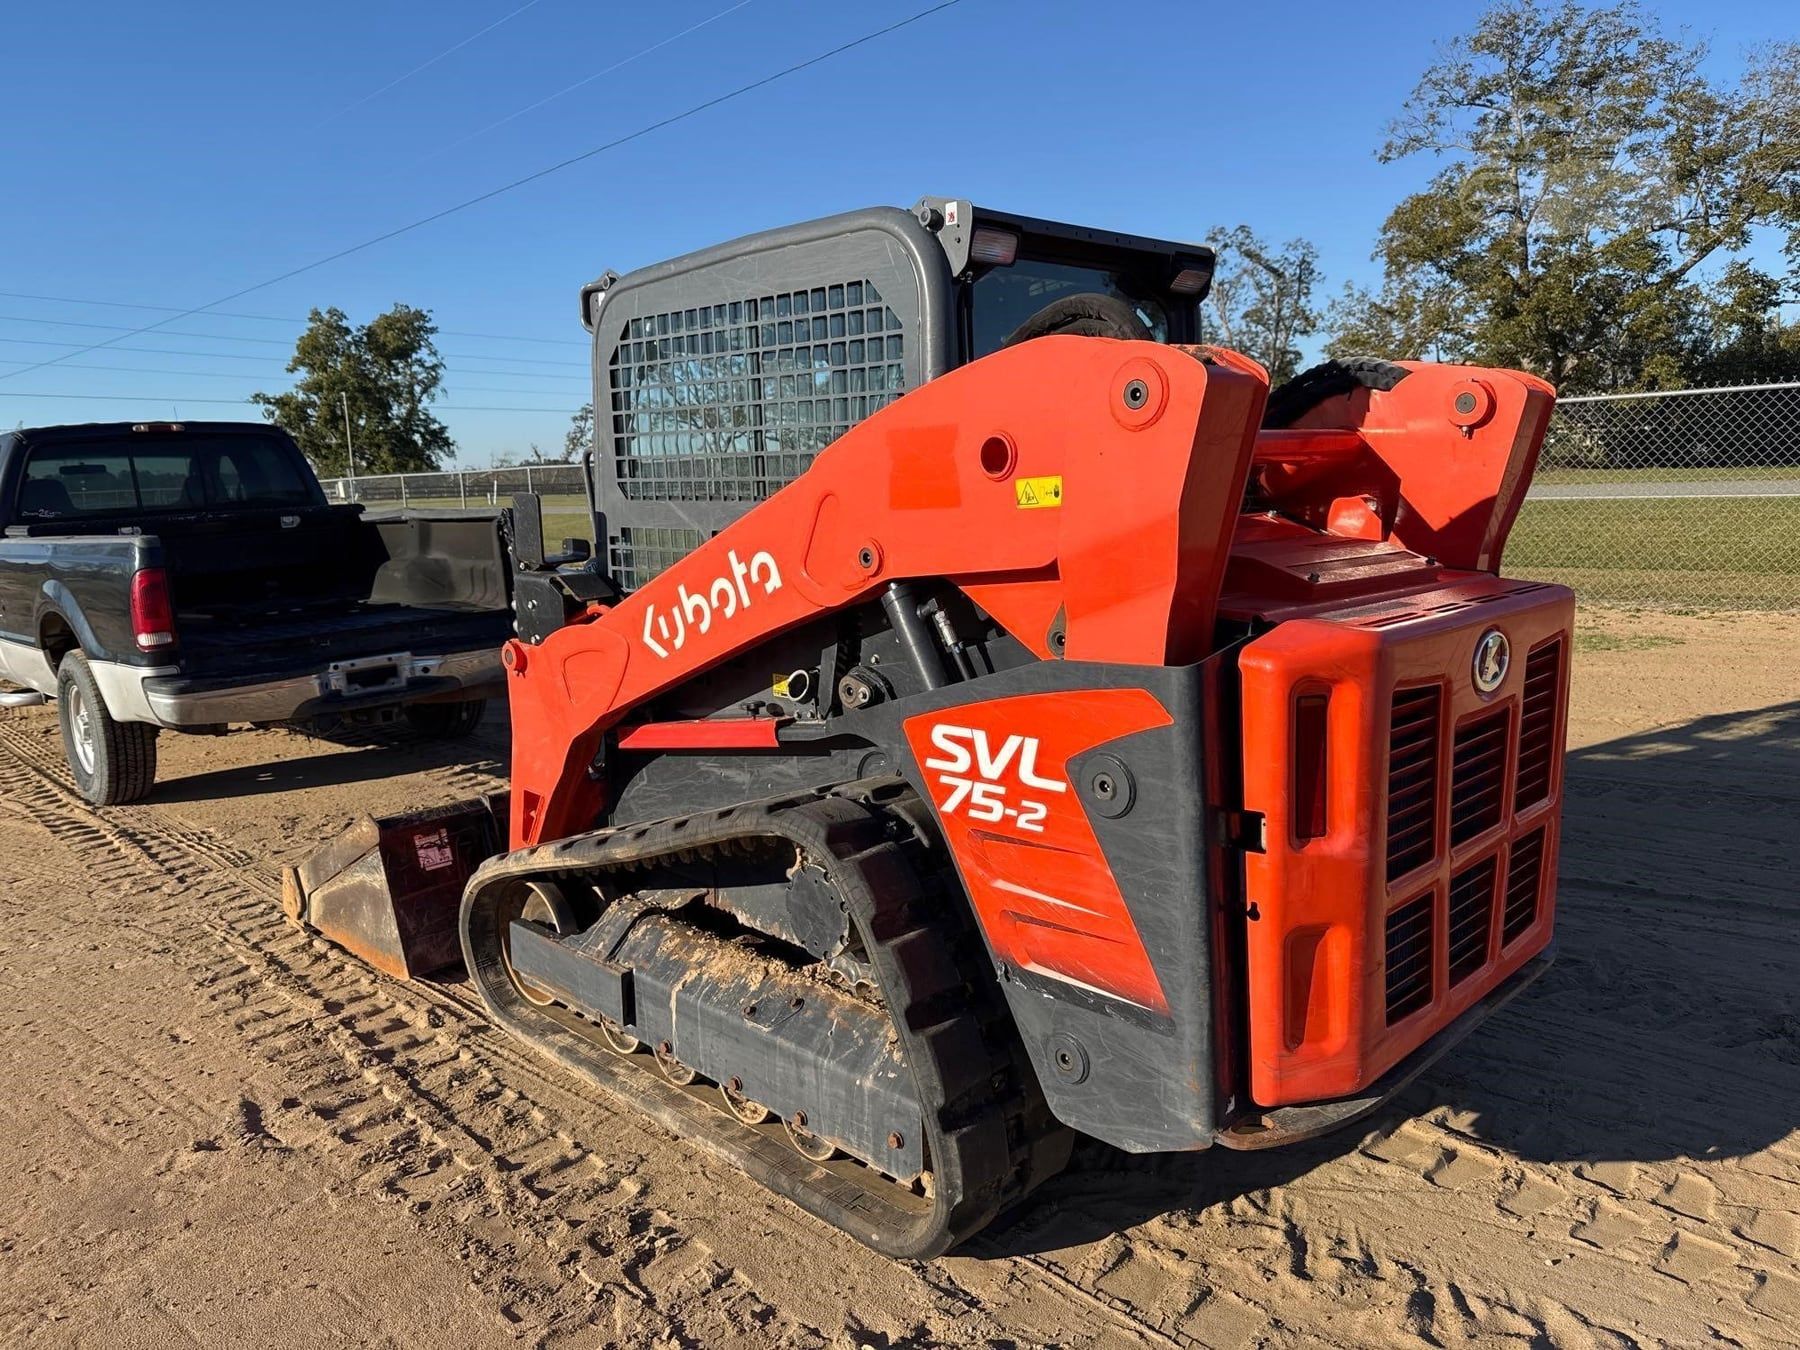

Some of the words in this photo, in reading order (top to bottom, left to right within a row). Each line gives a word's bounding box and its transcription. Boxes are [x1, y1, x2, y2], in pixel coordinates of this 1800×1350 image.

[643, 549, 783, 659] Kubota
[925, 724, 1067, 793] SVL
[939, 774, 1047, 832] 75-2
